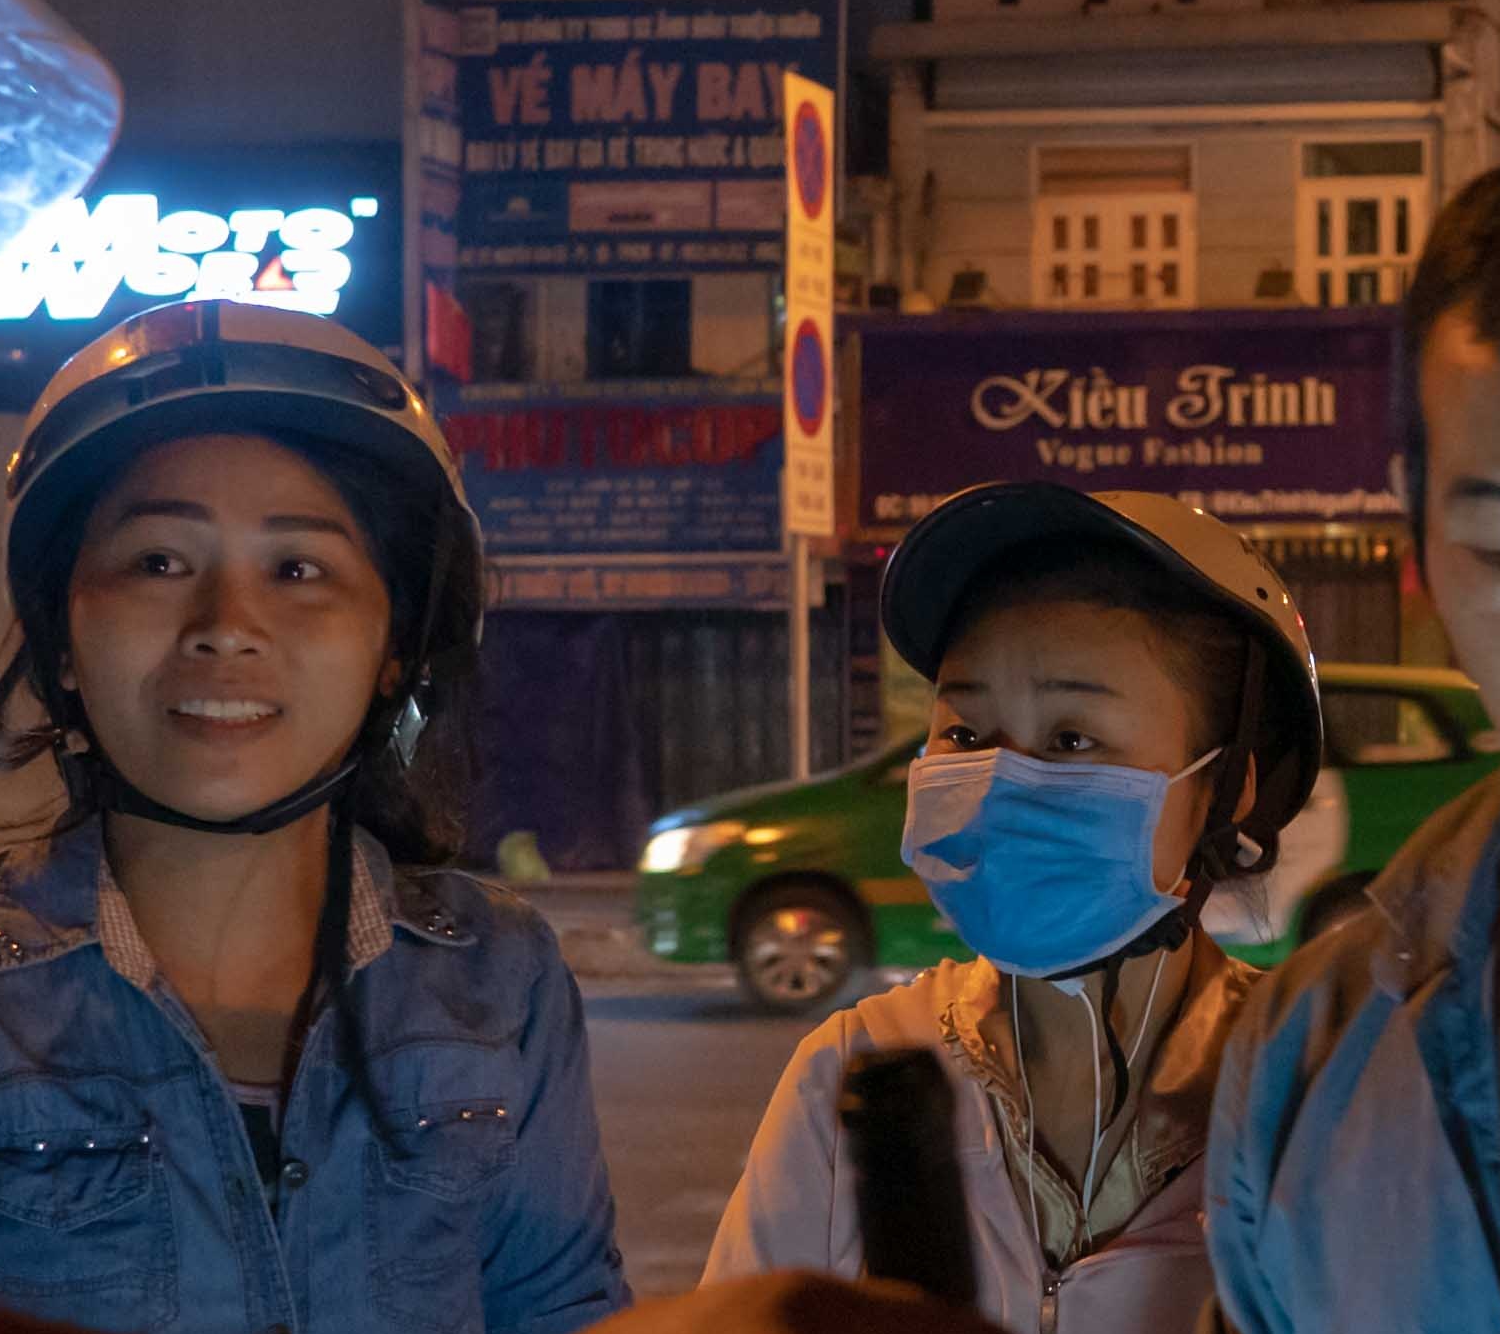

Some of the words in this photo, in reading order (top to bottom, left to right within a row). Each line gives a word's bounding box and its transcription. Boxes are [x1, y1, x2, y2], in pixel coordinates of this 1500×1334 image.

[489, 49, 553, 124] VÉ
[571, 47, 683, 123] MÁY
[1165, 364, 1337, 429] Trinh
[1035, 438, 1132, 471] Vogue
[1143, 434, 1264, 466] Fashion
